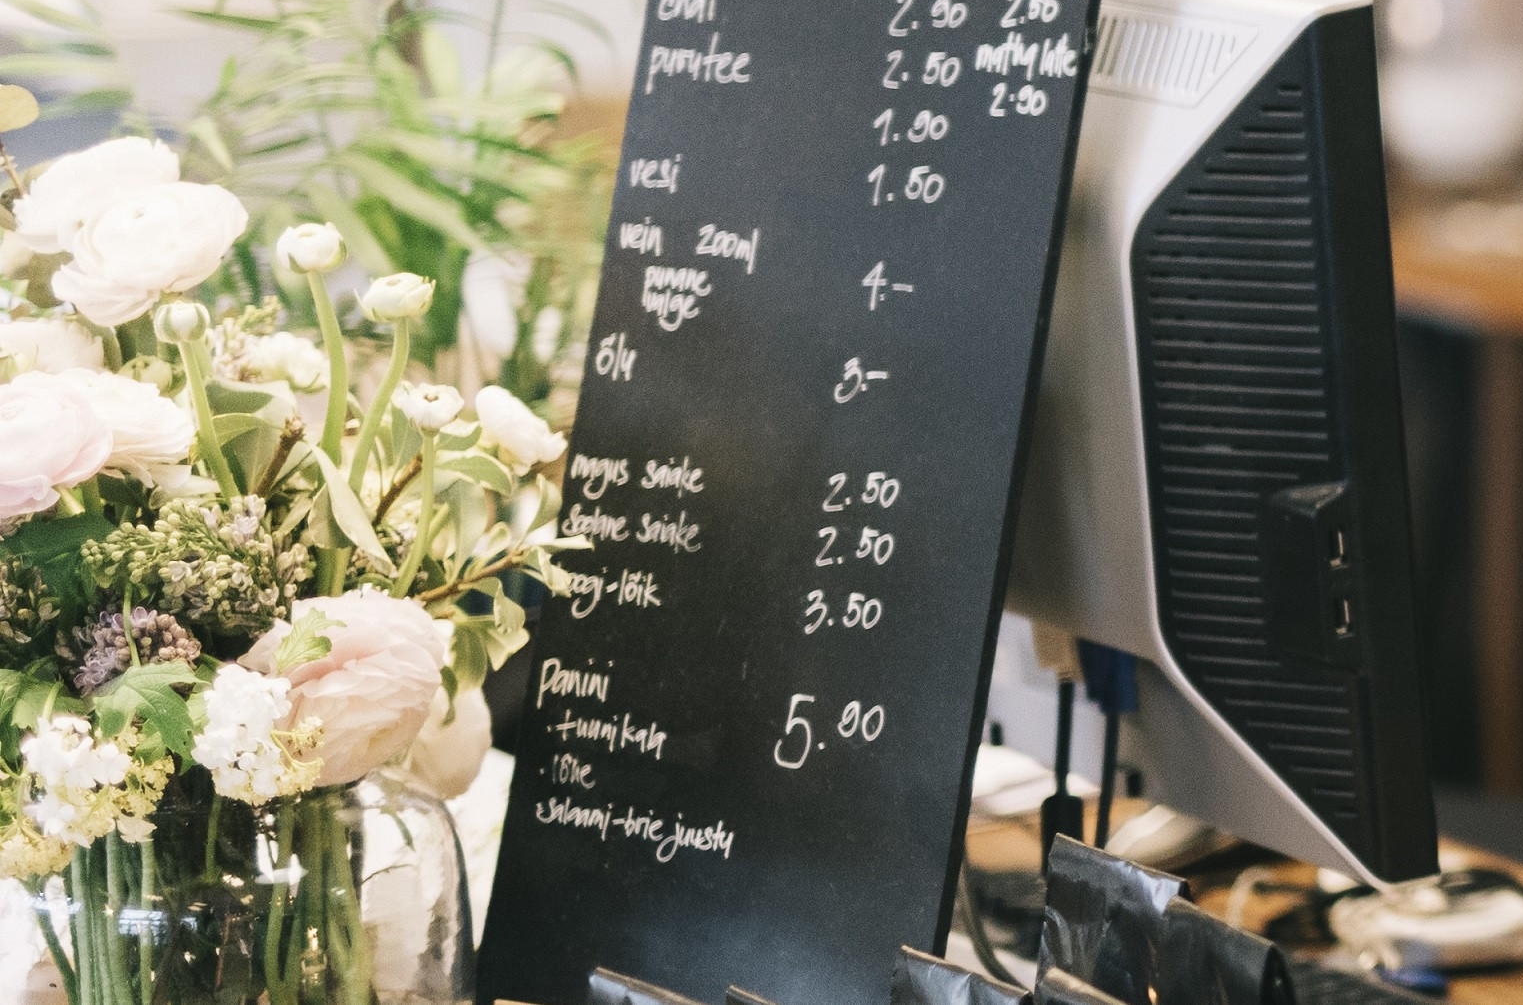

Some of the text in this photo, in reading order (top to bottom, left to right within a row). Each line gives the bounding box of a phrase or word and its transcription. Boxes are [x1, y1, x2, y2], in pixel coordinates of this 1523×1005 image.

[645, 31, 961, 95] purutee 2.50
[873, 108, 949, 145] 1.90
[630, 153, 945, 206] vesi 1.50
[620, 216, 760, 275] vein 200ml
[595, 331, 638, 381] õlu
[571, 453, 631, 501] magus
[823, 472, 899, 512] 2.50
[815, 526, 893, 567] 2.50
[553, 562, 882, 635] oogi-lõik 3.50
[774, 693, 884, 770] 5.90
